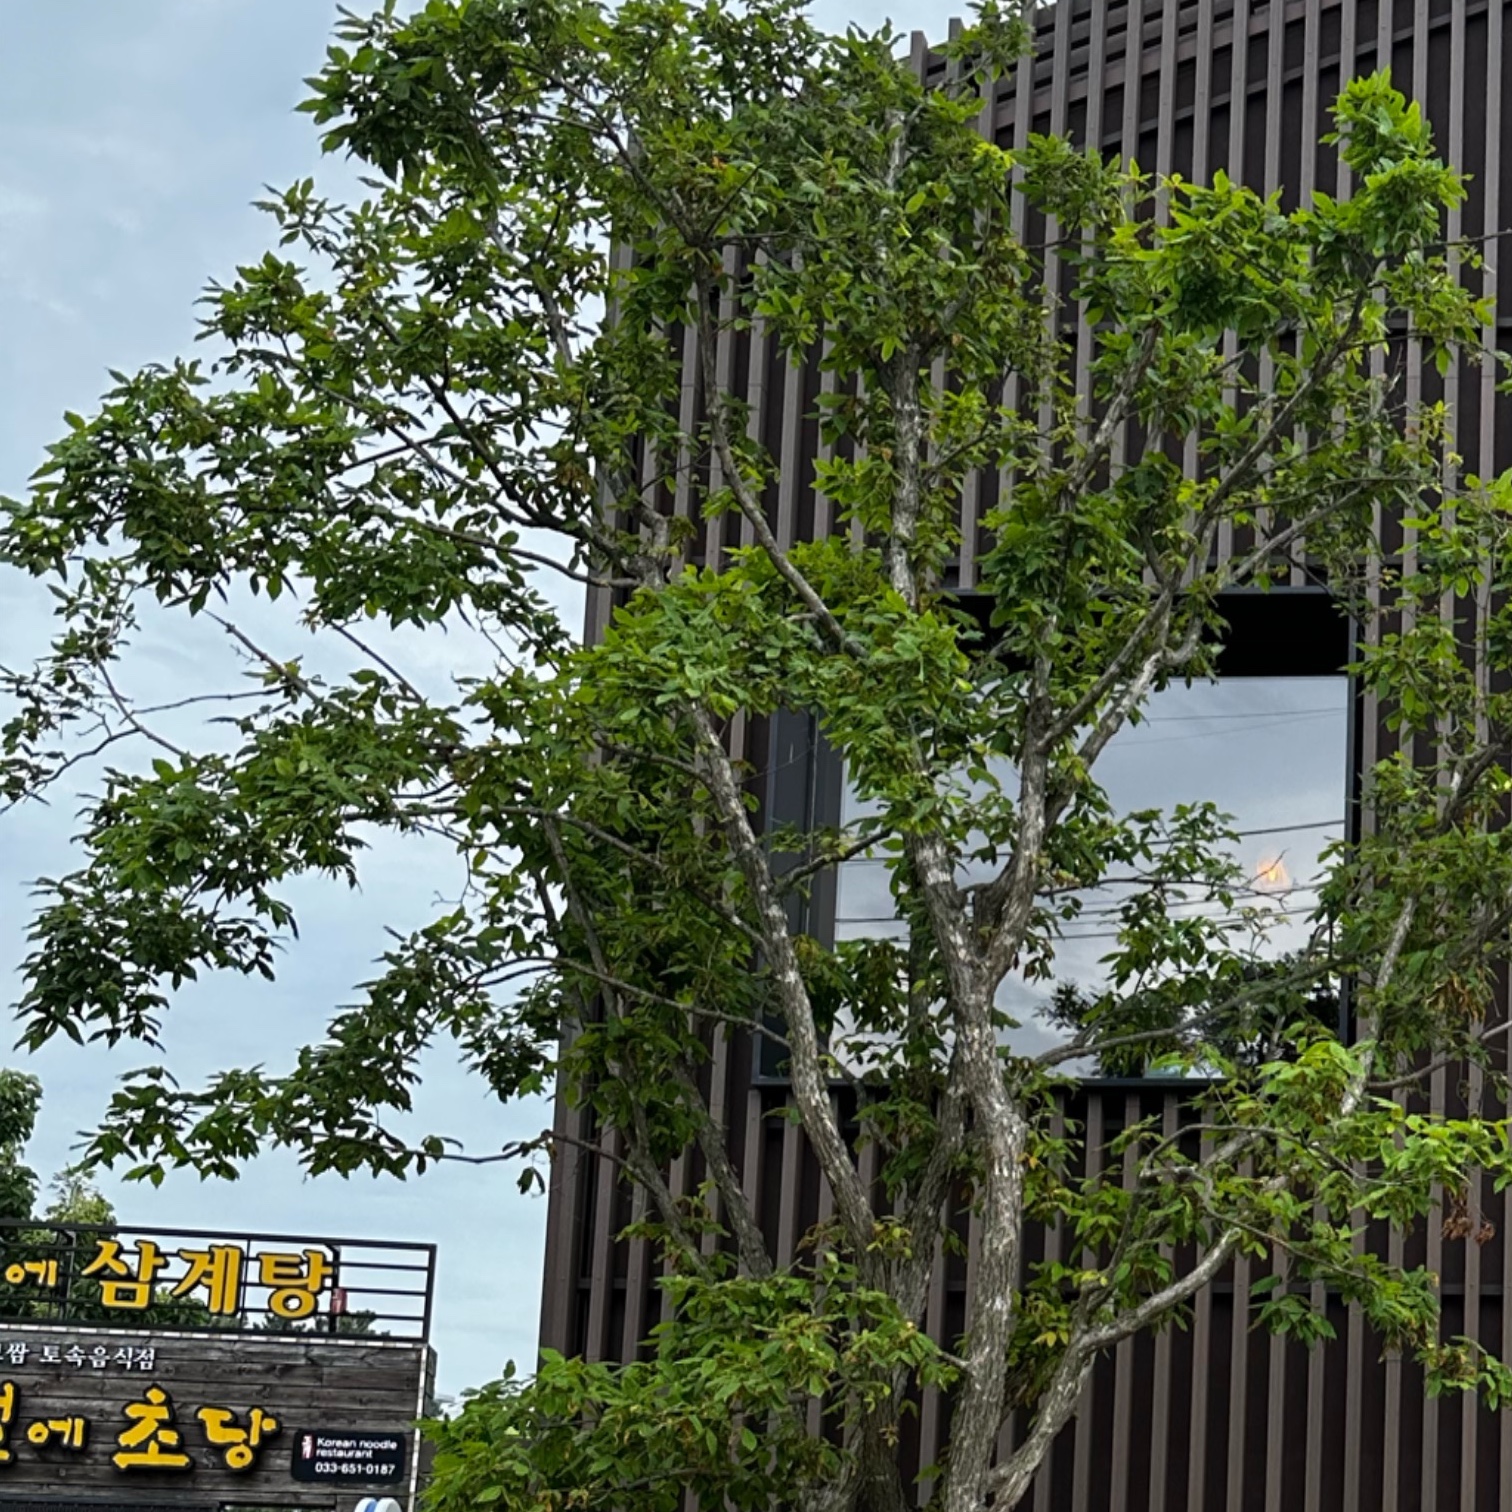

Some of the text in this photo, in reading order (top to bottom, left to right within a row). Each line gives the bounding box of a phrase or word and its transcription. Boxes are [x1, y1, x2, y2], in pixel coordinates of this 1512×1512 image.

[81, 1238, 333, 1319] 삼계탕
[0, 1342, 156, 1371] 쌈 토속음식점
[112, 1387, 278, 1470] 초당
[316, 1448, 373, 1459] restaurant
[317, 1437, 357, 1448] Korean
[359, 1439, 398, 1450] noodle
[315, 1461, 396, 1476] 033-651-0187
